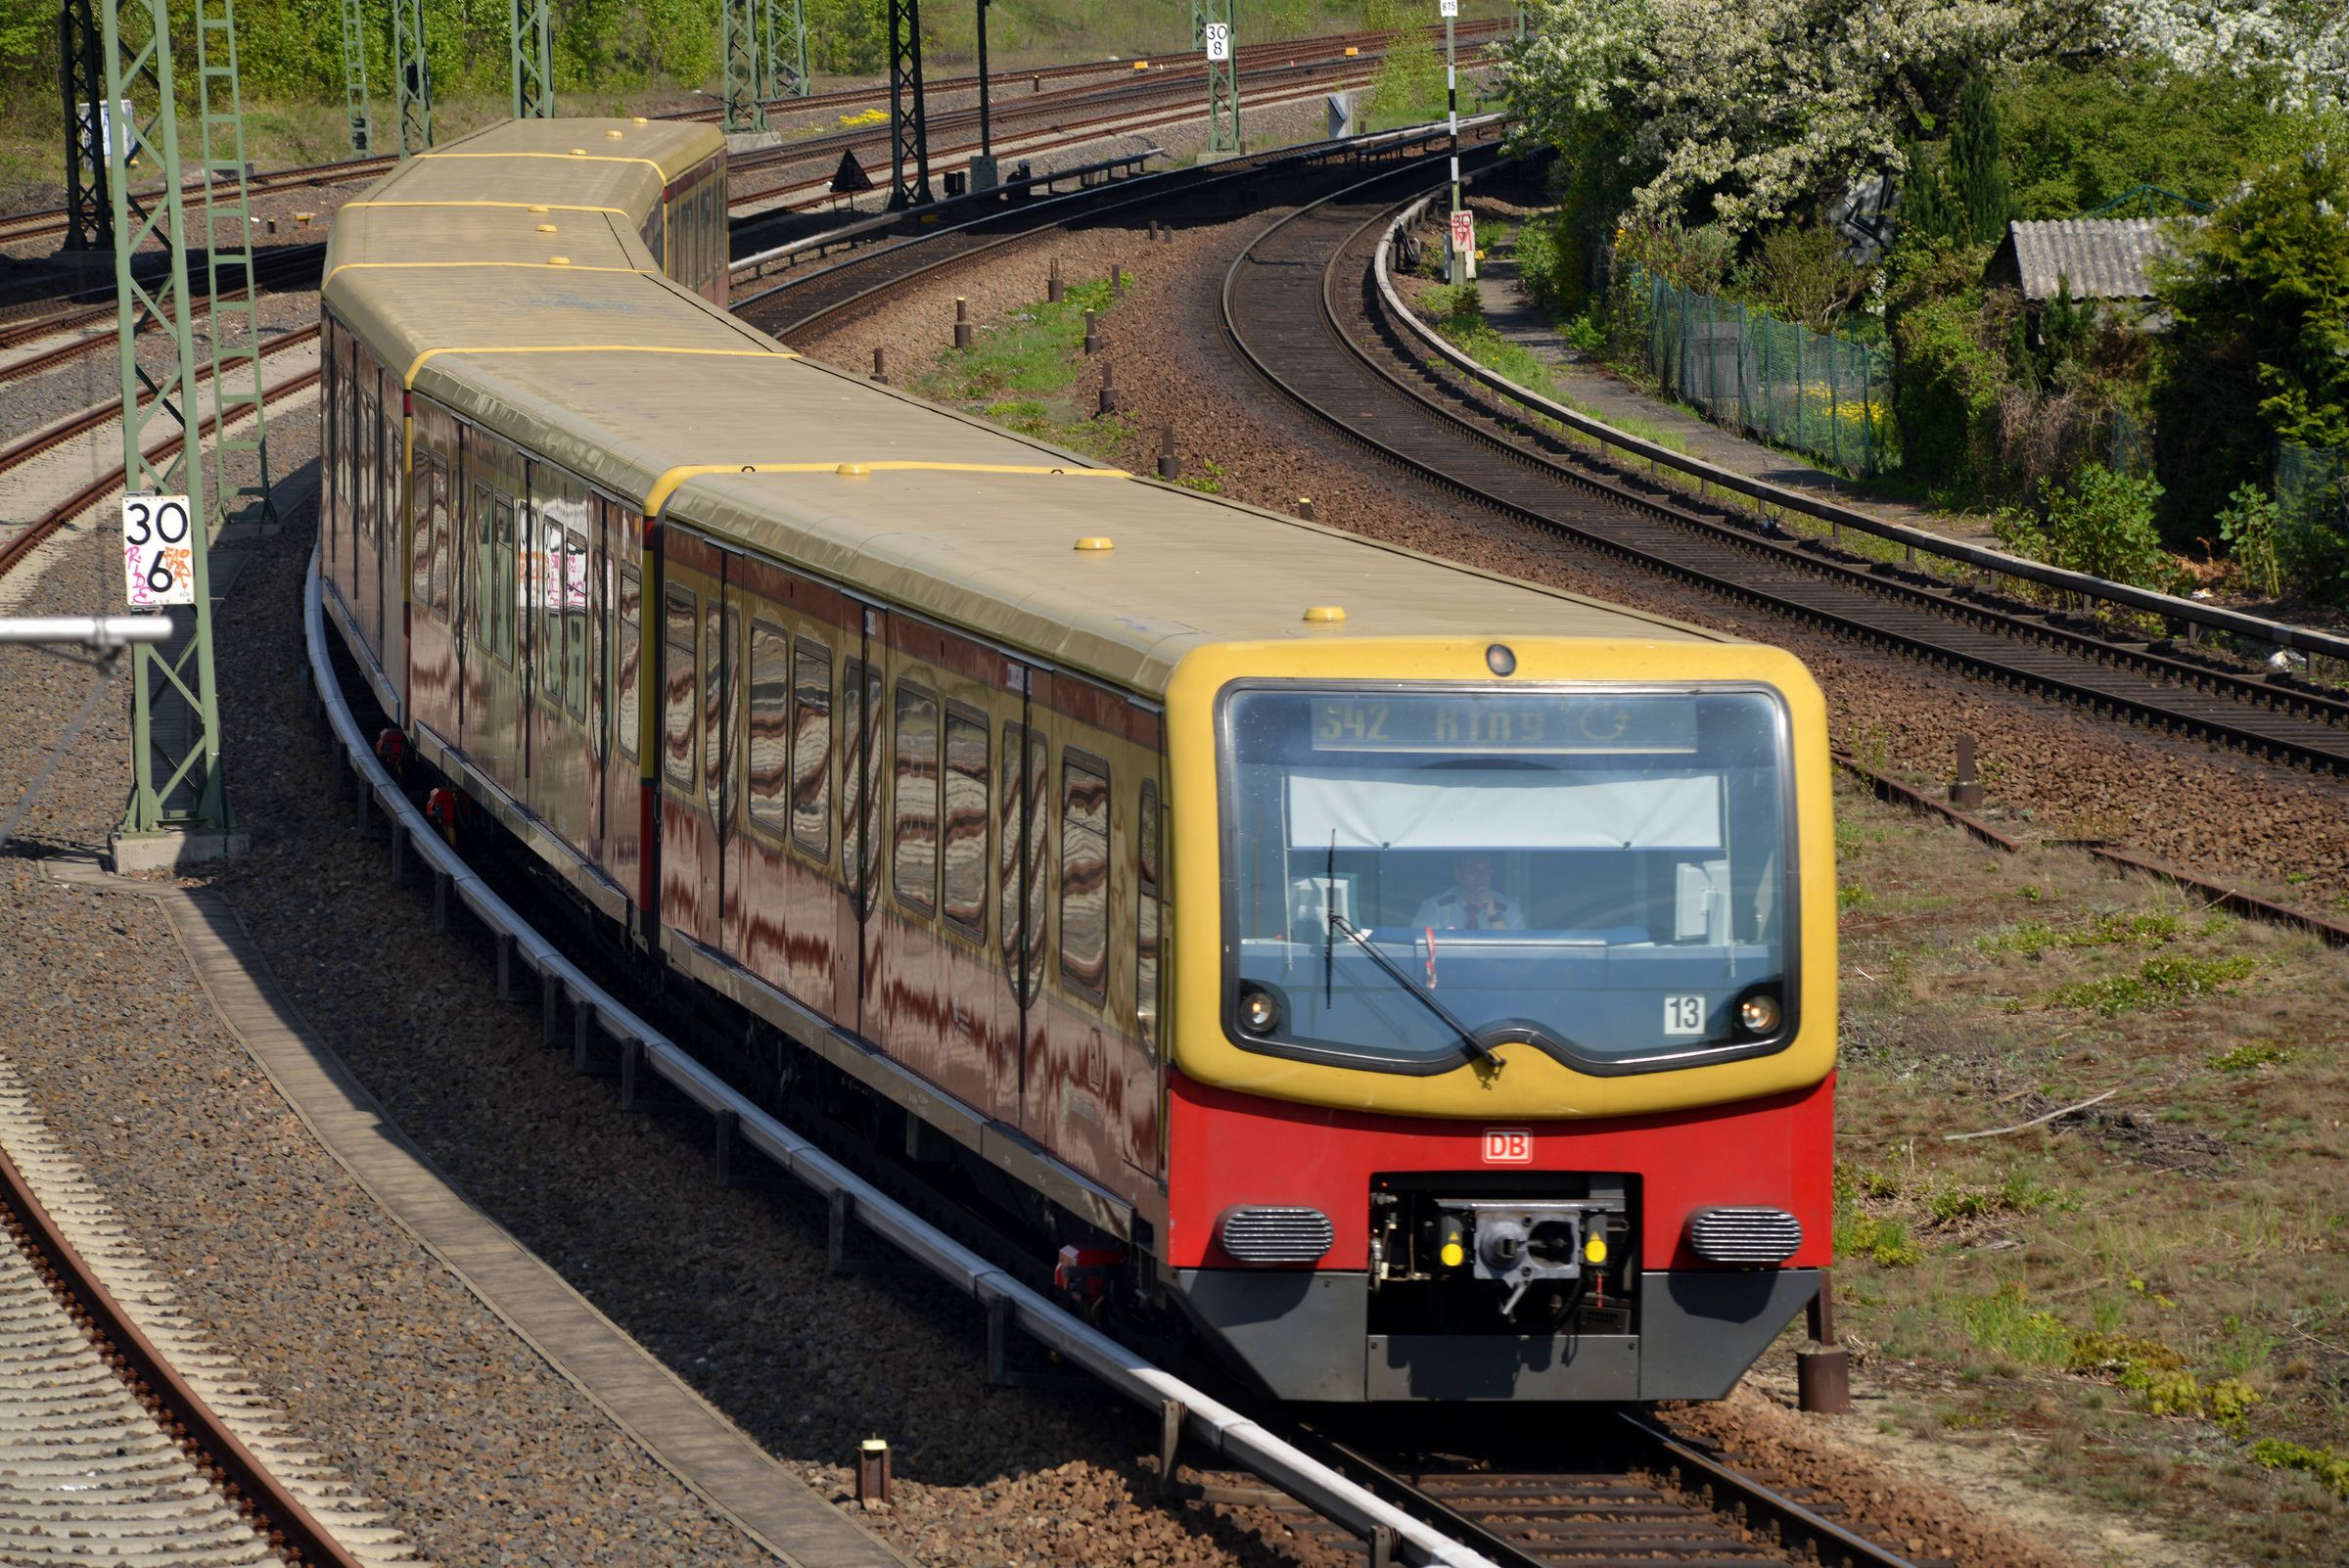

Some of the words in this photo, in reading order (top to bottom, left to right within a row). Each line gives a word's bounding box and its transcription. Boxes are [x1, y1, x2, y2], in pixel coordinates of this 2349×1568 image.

[1208, 25, 1227, 40] 30
[1214, 41, 1222, 56] 8
[1451, 213, 1472, 229] 30
[126, 502, 188, 545] 30
[147, 550, 173, 593] 6
[1319, 703, 1389, 740] S42
[1435, 704, 1545, 742] Ring
[1670, 997, 1699, 1029] 13
[1490, 1133, 1525, 1157] DB
